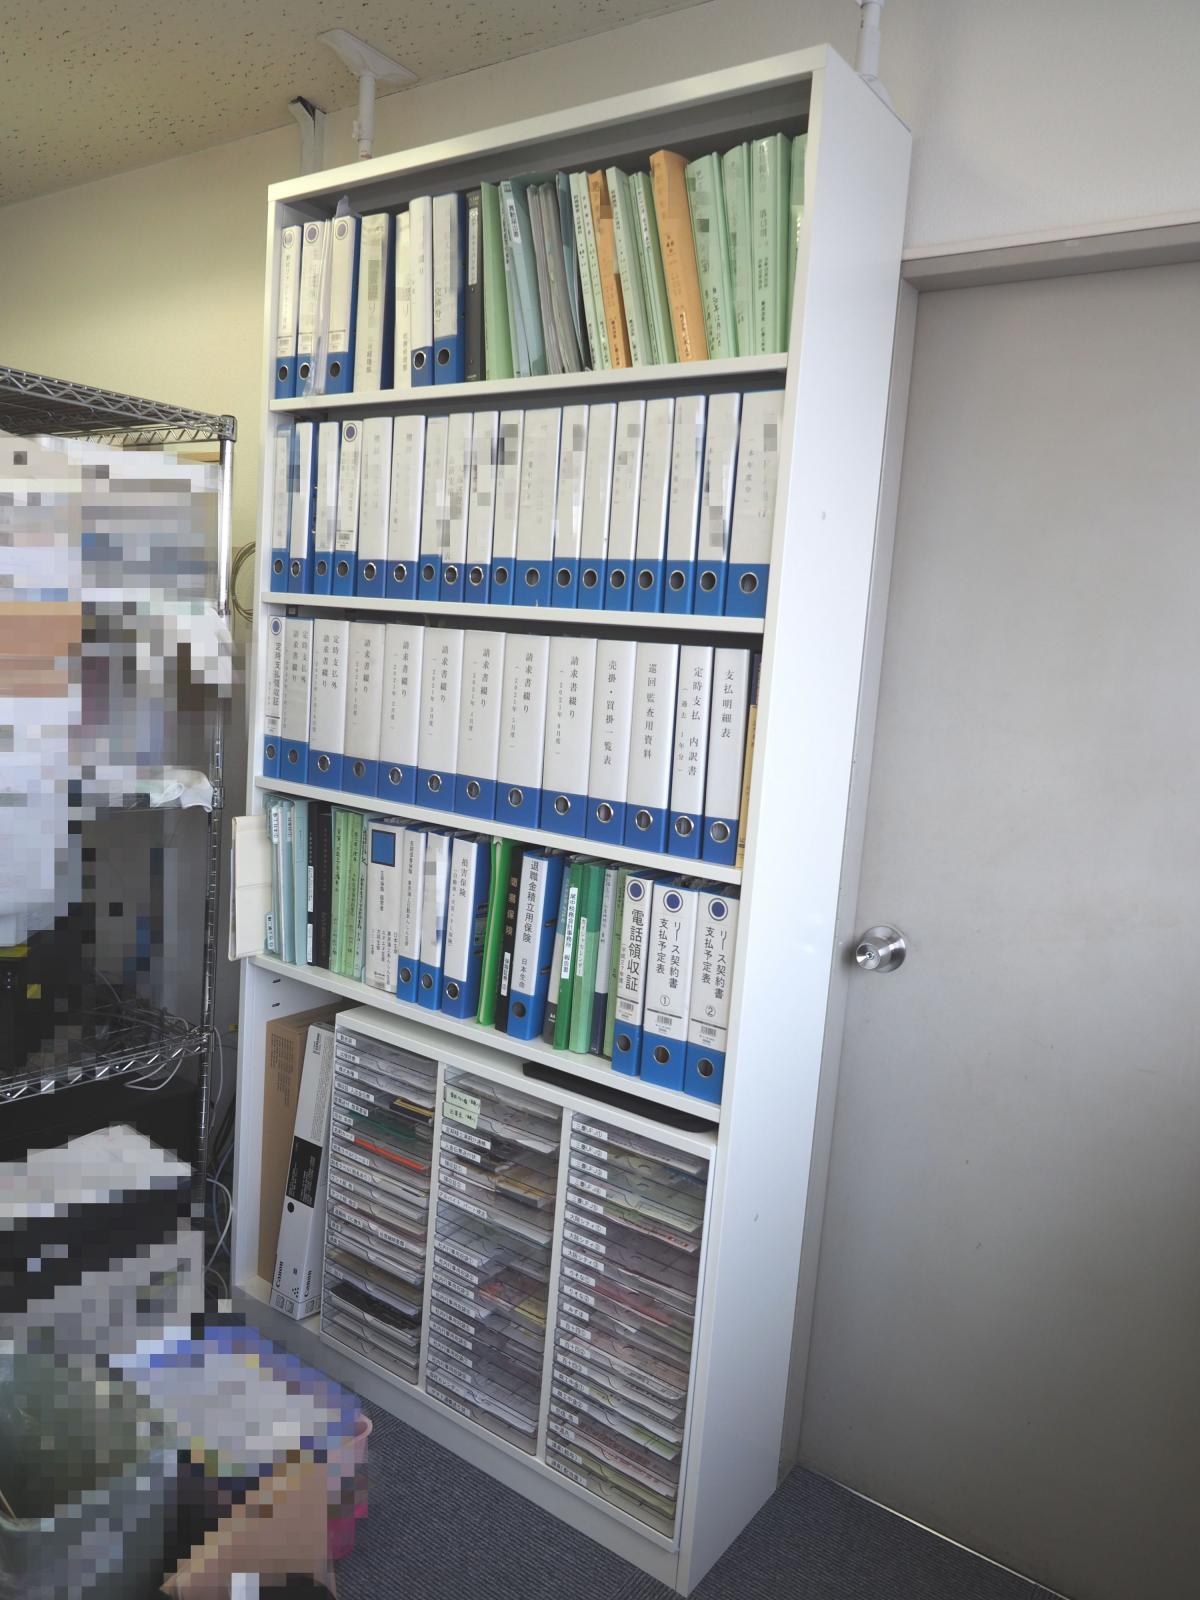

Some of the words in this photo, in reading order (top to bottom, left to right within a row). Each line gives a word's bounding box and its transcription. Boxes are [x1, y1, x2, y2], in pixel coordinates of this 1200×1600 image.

[363, 640, 371, 694] 請求書綴り
[401, 641, 410, 697] 請求書綴り
[440, 646, 449, 703] 請求書綴り
[481, 648, 490, 709] 請求書綴り
[523, 652, 533, 714] 請求書綴り
[569, 656, 579, 719] 請求書綴り
[691, 667, 703, 721] 定時支払
[604, 660, 617, 766] 売掛・買掛一覧表
[643, 663, 657, 760] 巡回監査用資料
[720, 669, 734, 738] 支払明細表
[688, 736, 699, 777] 内訳書
[522, 860, 539, 944] 退職金積立用保険
[625, 909, 644, 992] 電話領収証
[656, 919, 668, 975] 支払予定表
[669, 922, 681, 989] リース契約書
[702, 926, 715, 985] 支払予定表
[715, 930, 727, 1000] リース契約書
[275, 1261, 284, 1288] Canon
[304, 1270, 312, 1298] Canon
